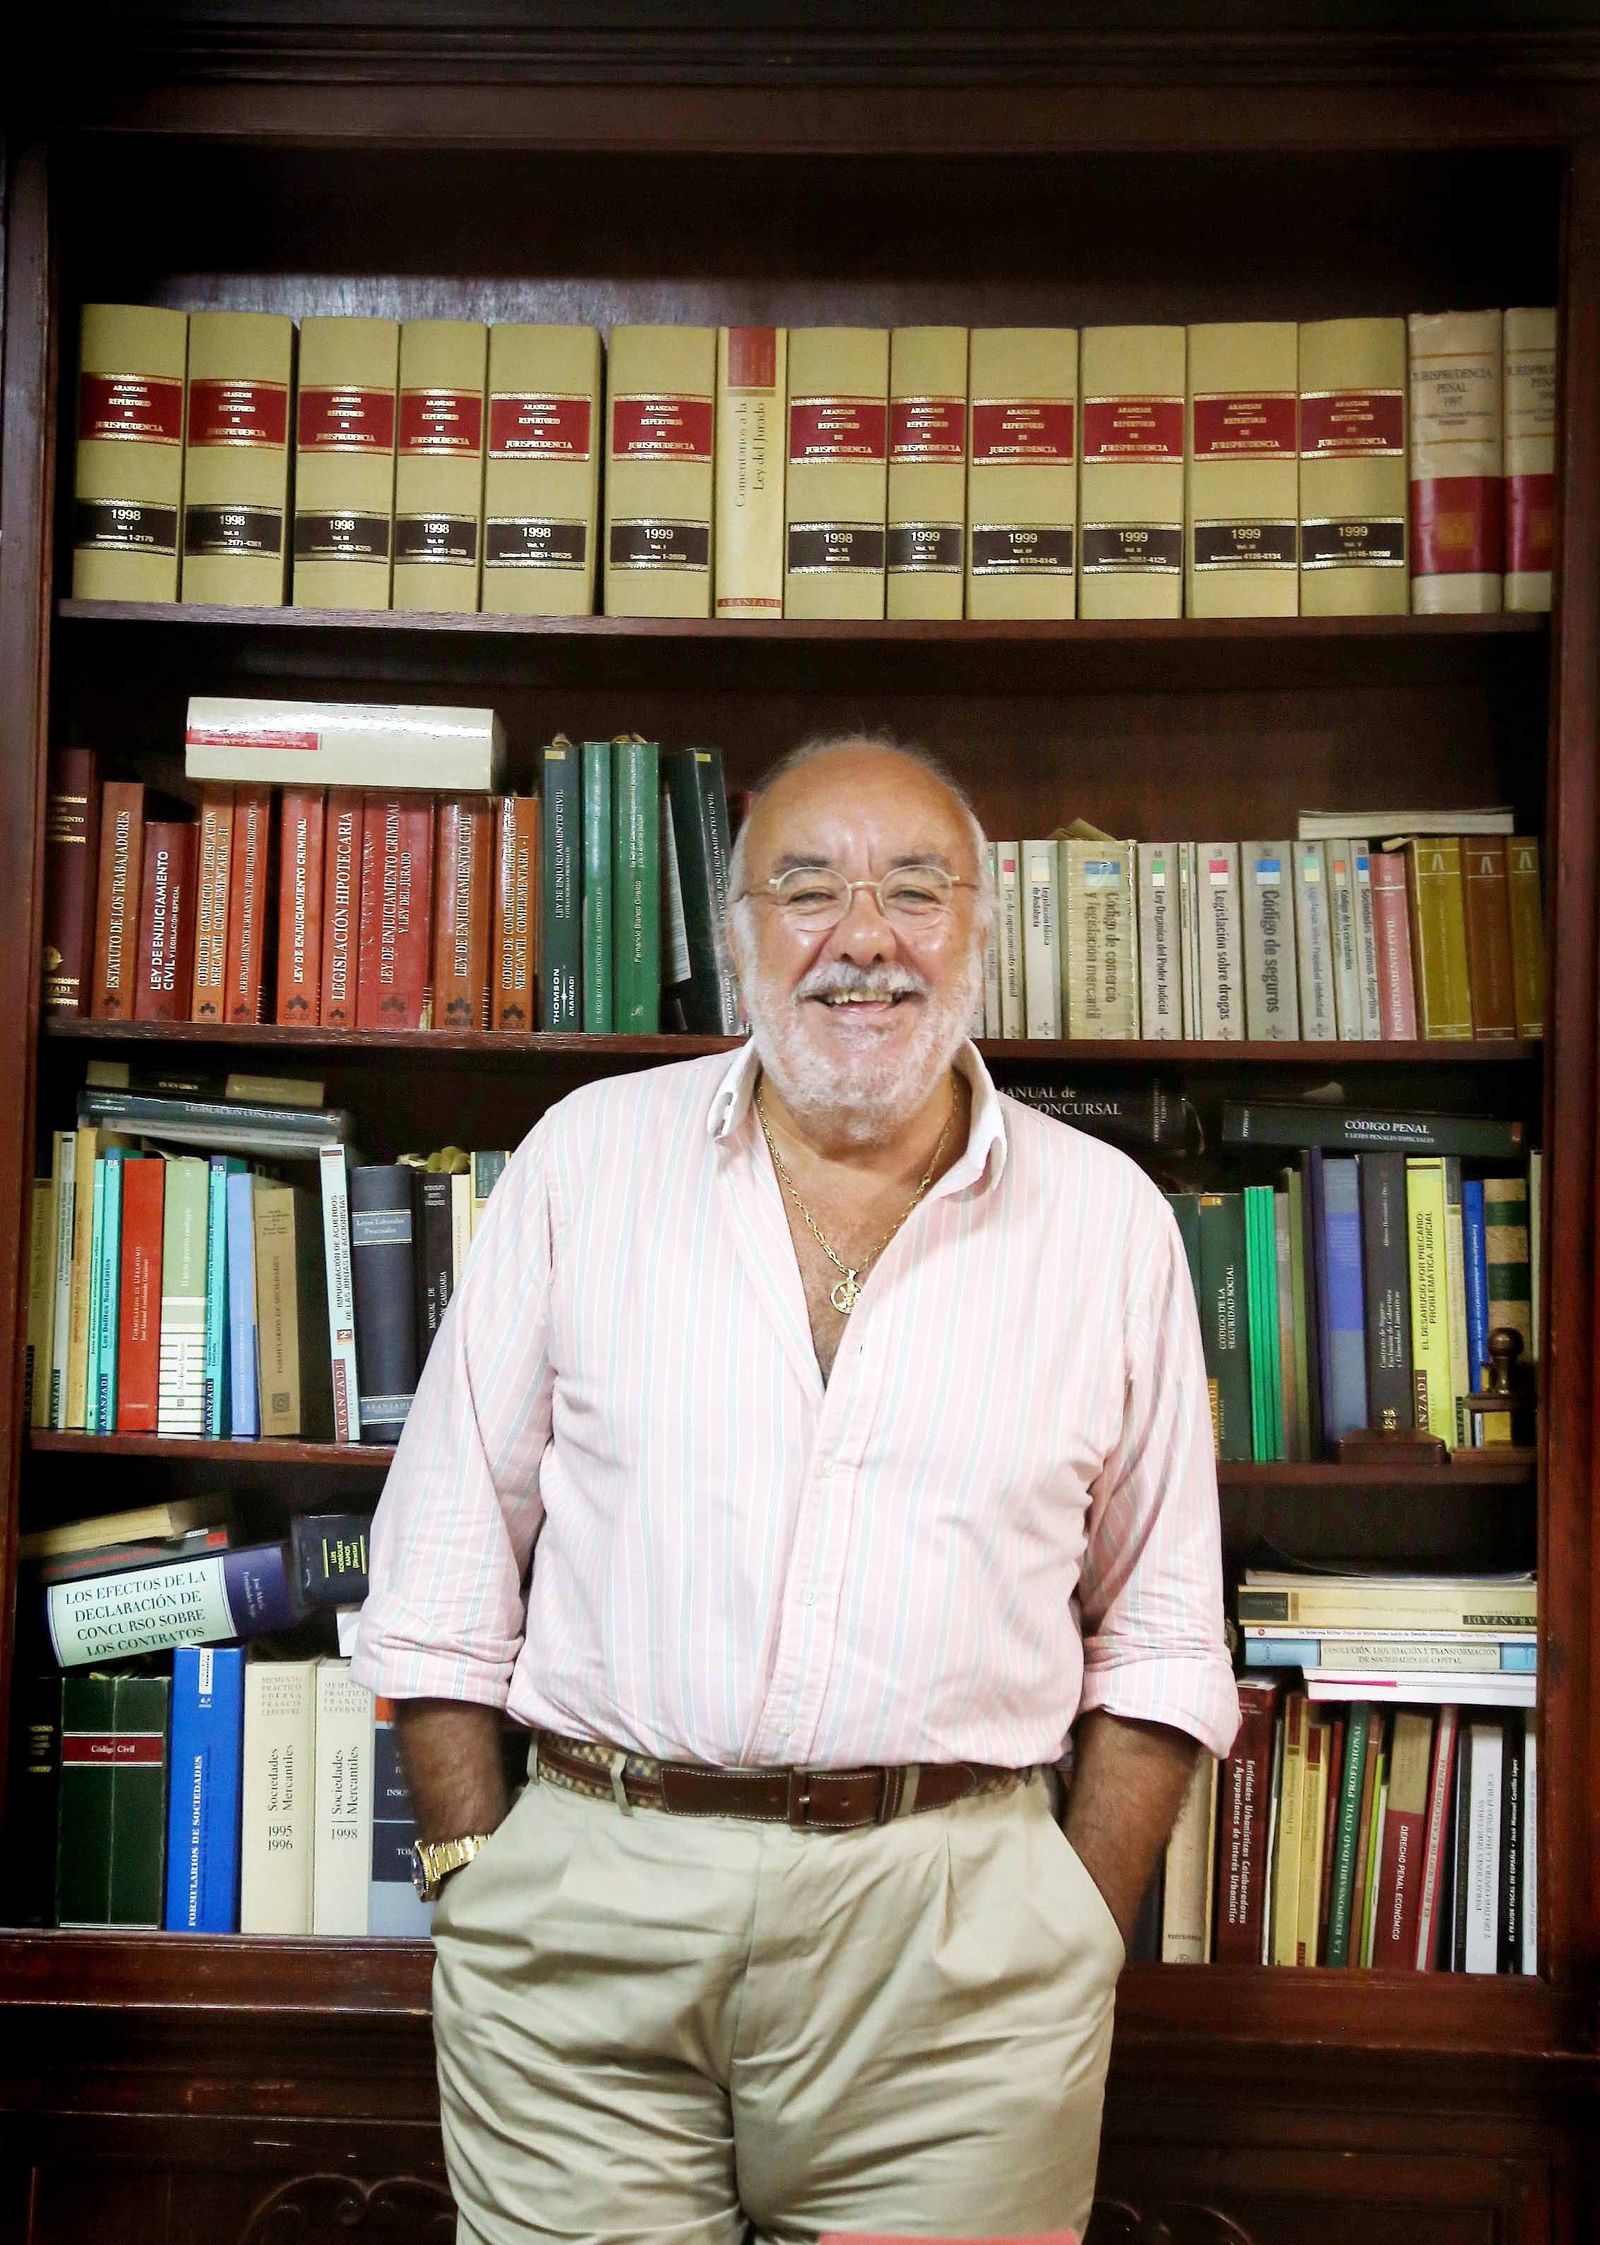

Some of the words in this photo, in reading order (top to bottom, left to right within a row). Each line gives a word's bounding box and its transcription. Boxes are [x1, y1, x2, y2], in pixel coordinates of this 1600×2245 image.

[753, 403, 768, 442] Jurado
[628, 441, 695, 450] JURISPRUDENCIA
[752, 447, 764, 464] del
[753, 469, 766, 489] Ley
[111, 509, 141, 521] 1998
[220, 515, 245, 526] 1998
[328, 520, 355, 530] 1998
[424, 523, 449, 534] 1998
[522, 528, 551, 538] 1998
[644, 528, 674, 539] 1999
[824, 533, 853, 544] 1998
[911, 531, 940, 542] 1999
[1008, 533, 1038, 544] 1999
[1119, 532, 1148, 543] 1999
[1231, 529, 1261, 540] 1999
[1339, 526, 1368, 537] 1999
[386, 801, 400, 852] CRIMINAL
[458, 814, 472, 843] CIVIL
[112, 810, 130, 892] TRABAJADORES
[296, 818, 306, 864] CRIMINAL
[335, 811, 353, 904] HIPOTECARIA
[400, 852, 411, 886] JURADO
[152, 850, 169, 947] ENJUICIAMIENTO
[381, 855, 398, 944] ENJUICIAMIENTO
[399, 889, 410, 905] DEL
[455, 846, 471, 935] ENJUICIAMIENTO
[1154, 890, 1165, 904] Ley
[111, 896, 124, 916] LOS
[294, 867, 305, 947] ENJUICIAMIENTO
[398, 908, 409, 924] LEY
[1260, 890, 1280, 934] Código
[110, 918, 122, 932] DE
[162, 959, 175, 990] CIVIL
[171, 885, 180, 912] ESPECIAL
[455, 938, 468, 952] DE
[1264, 939, 1280, 955] de
[150, 950, 162, 965] DE
[294, 950, 303, 962] DE
[330, 908, 349, 1000] LEGISLACIÓN
[381, 946, 394, 960] DE
[1156, 944, 1166, 955] del
[107, 935, 121, 988] ESTATUTO
[293, 964, 302, 982] LEY
[380, 962, 393, 983] LEY
[454, 956, 467, 976] LEY
[1156, 958, 1167, 980] Poder
[1216, 951, 1231, 980] sobre
[149, 968, 161, 989] LEY
[1261, 959, 1279, 1012] seguros
[1157, 984, 1168, 1014] Judicial
[1216, 984, 1232, 1020] drogas
[1061, 1086, 1076, 1098] de
[1392, 1122, 1429, 1134] PENAL
[330, 1195, 340, 1237] ACUERDOS
[338, 1194, 347, 1245] ACCIONISTAS
[1423, 1211, 1433, 1250] JUDICIAL
[332, 1240, 340, 1250] DE
[341, 1248, 348, 1258] DE
[103, 1258, 111, 1302] Societarios
[342, 1260, 350, 1289] JUNTAS
[1417, 1261, 1426, 1280] POR
[427, 1287, 435, 1296] DE
[1217, 1288, 1225, 1298] LA
[344, 1309, 351, 1320] DE
[1217, 1301, 1225, 1312] DE
[1418, 1283, 1428, 1336] DESAHUCIO
[1226, 1298, 1235, 1349] SEGURIDAD
[1420, 1338, 1429, 1350] EL
[205, 1380, 214, 1431] ARANZADI
[335, 1364, 347, 1434] ARANZADI
[65, 1589, 93, 1604] LOS
[95, 1578, 161, 1599] EFECTOS
[163, 1574, 184, 1588] DE
[188, 1570, 206, 1584] LA
[73, 1591, 176, 1622] DECLARACIÓN
[180, 1589, 201, 1604] DE
[76, 1616, 156, 1640] CONCURSO
[158, 1608, 205, 1626] SOBRE
[85, 1642, 114, 1656] LOS
[117, 1626, 204, 1650] CONTRATOS
[1347, 1725, 1362, 1797] PROFESIONAL
[267, 1748, 279, 1811] Sociedades
[282, 1744, 294, 1810] Mercantiles
[331, 1749, 343, 1814] Sociedades
[346, 1746, 359, 1814] Mercantiles
[1244, 1760, 1255, 1802] Entidades
[191, 1755, 203, 1825] SOCIEDADES
[1232, 1767, 1243, 1824] Agrupaciones
[1344, 1801, 1354, 1830] CIVIL
[190, 1828, 200, 1843] DE
[268, 1826, 292, 1837] 1995
[331, 1829, 358, 1840] 1998
[1233, 1828, 1240, 1838] de
[268, 1839, 293, 1850] 1996
[1397, 1825, 1408, 1863] DERECHO
[1231, 1842, 1240, 1870] Interés
[187, 1846, 199, 1926] FORMULARIOS
[1334, 1834, 1352, 1935] RESPONSABILIDAD
[1395, 1865, 1405, 1890] PENAL
[1509, 1875, 1516, 1884] EN
[1238, 1860, 1250, 1923] Colaboradoras
[1391, 1893, 1404, 1940] ECONÓMICO
[1333, 1938, 1342, 1953] LA
